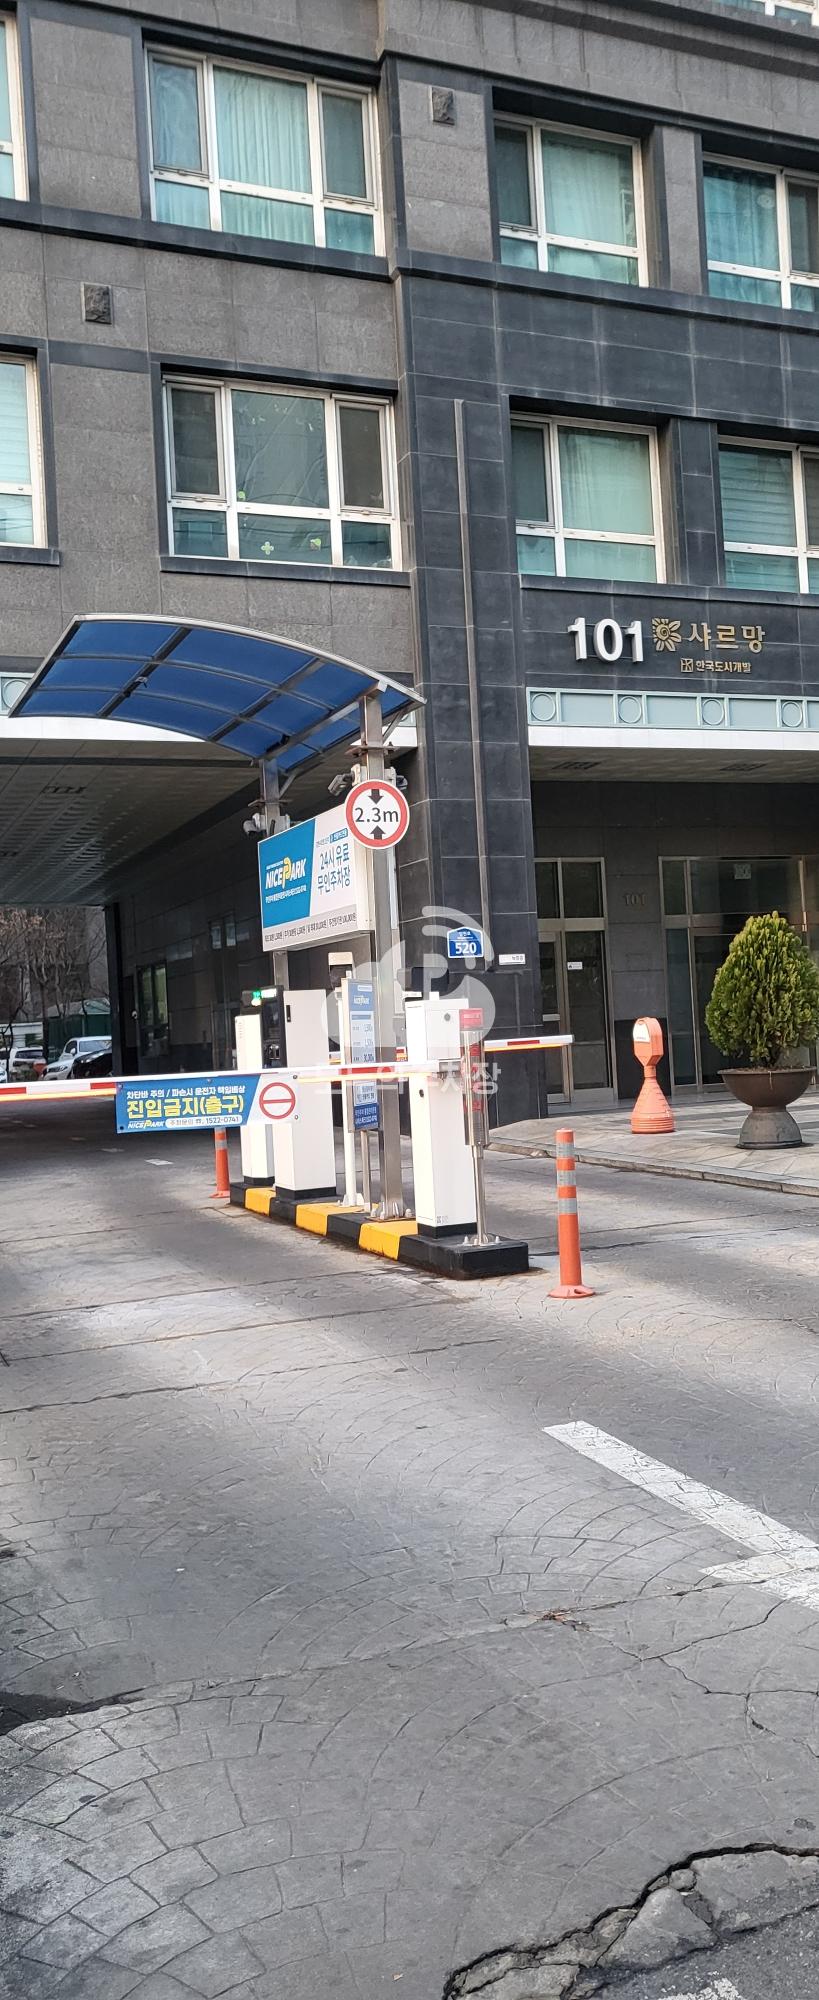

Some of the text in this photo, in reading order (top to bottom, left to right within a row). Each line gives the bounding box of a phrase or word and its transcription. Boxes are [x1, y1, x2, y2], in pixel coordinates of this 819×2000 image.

[567, 617, 644, 663] 101
[688, 622, 766, 654] 샤르망
[695, 660, 752, 674] 한국도시개발
[354, 807, 399, 823] 2.3m
[320, 843, 350, 870] 24시 유료
[317, 865, 351, 895] 무인주차장
[455, 942, 477, 954] 520
[127, 1090, 149, 1100] 차단바
[150, 1089, 165, 1098] 주의
[172, 1088, 194, 1097] 파손시
[195, 1086, 217, 1096] 운전자
[127, 1094, 244, 1119] 진입금지(출구)
[206, 1116, 239, 1124] 1522-0741
